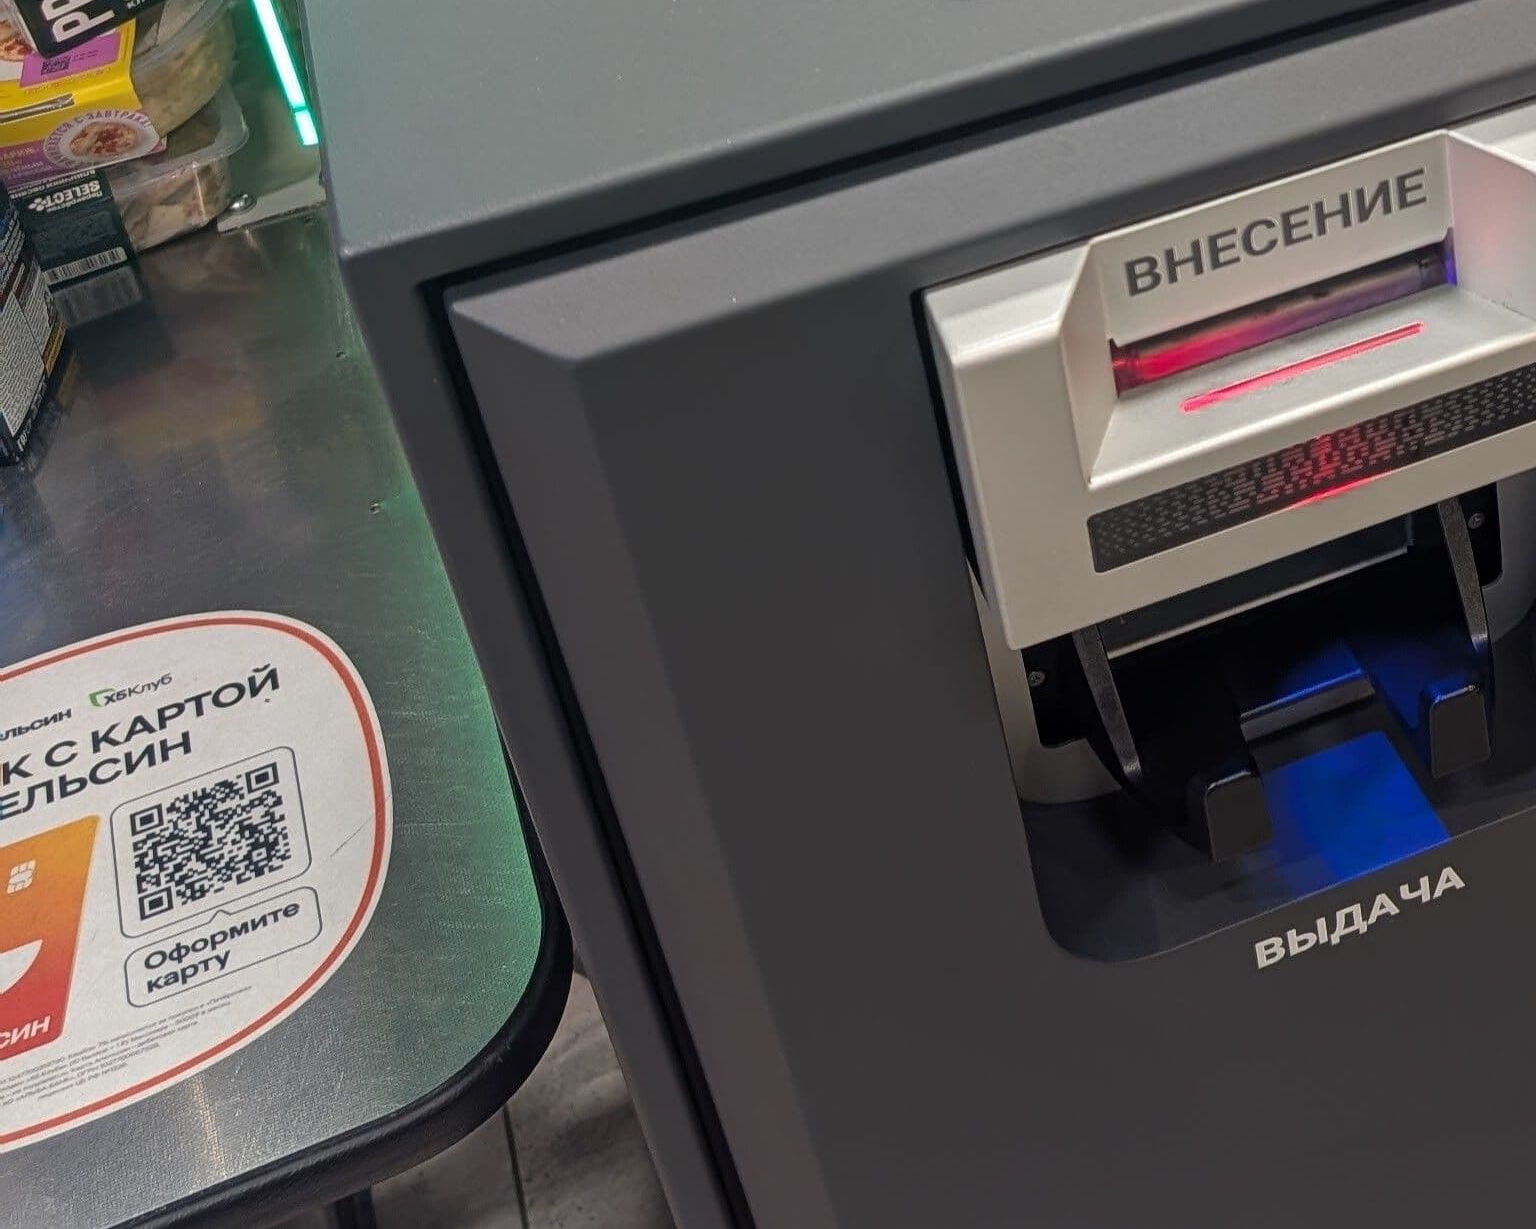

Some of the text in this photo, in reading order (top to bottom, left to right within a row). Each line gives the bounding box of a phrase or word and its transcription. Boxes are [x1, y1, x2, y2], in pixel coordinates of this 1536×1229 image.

[47, 180, 101, 206] SELECT
[1125, 168, 1428, 297] ВНЕСЕНИЕ
[45, 740, 78, 768] С
[91, 663, 280, 754] КАРТОЙ
[0, 730, 192, 820] ЕЛЬСИН
[144, 903, 300, 970] Оформите
[1254, 866, 1466, 969] ВЫДАЧА
[146, 950, 231, 994] карту
